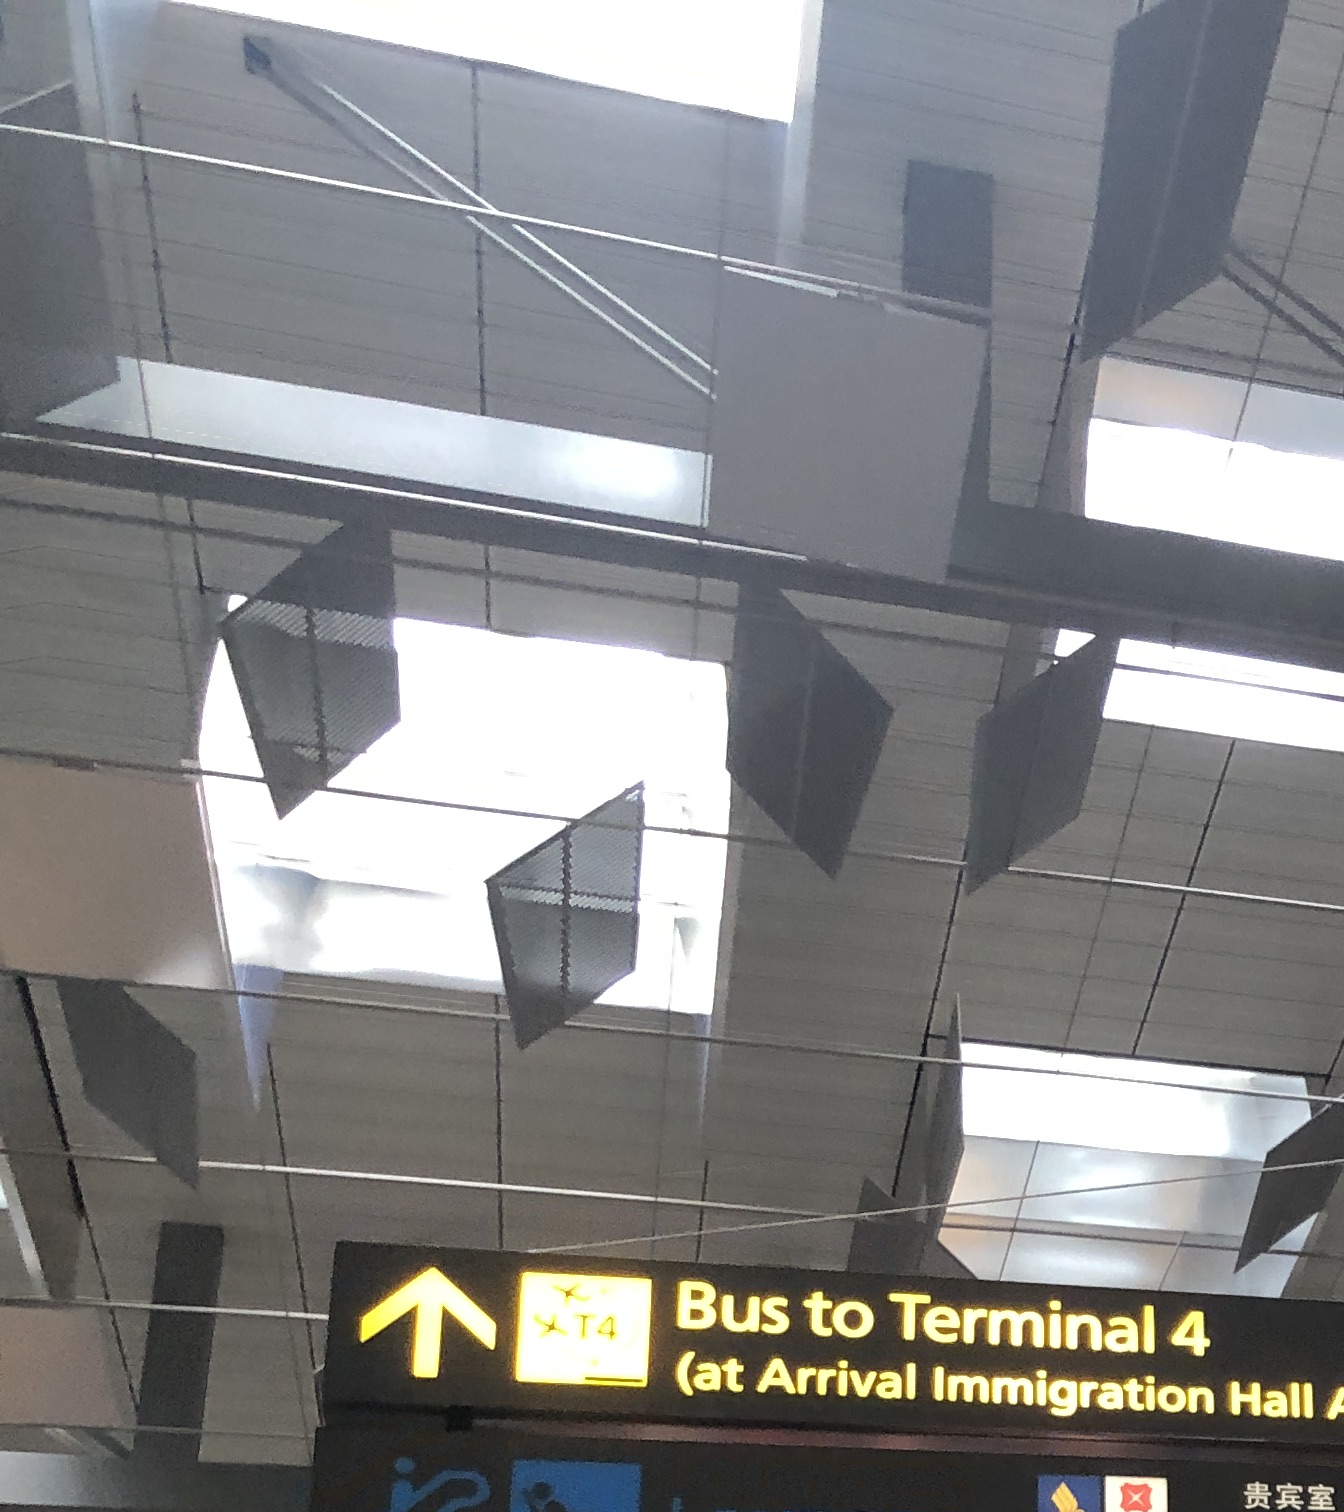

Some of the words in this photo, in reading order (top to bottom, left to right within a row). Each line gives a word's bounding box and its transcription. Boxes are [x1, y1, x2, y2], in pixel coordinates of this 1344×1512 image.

[675, 1280, 789, 1334] Bus
[803, 1291, 874, 1338] to
[889, 1291, 1157, 1353] Terminal
[1169, 1311, 1210, 1356] 4
[675, 1351, 744, 1396] (at
[756, 1358, 916, 1399] Arrival
[932, 1366, 1214, 1416] Immigration
[1228, 1381, 1313, 1418] Hall
[1243, 1482, 1335, 1510] 贵宾室
